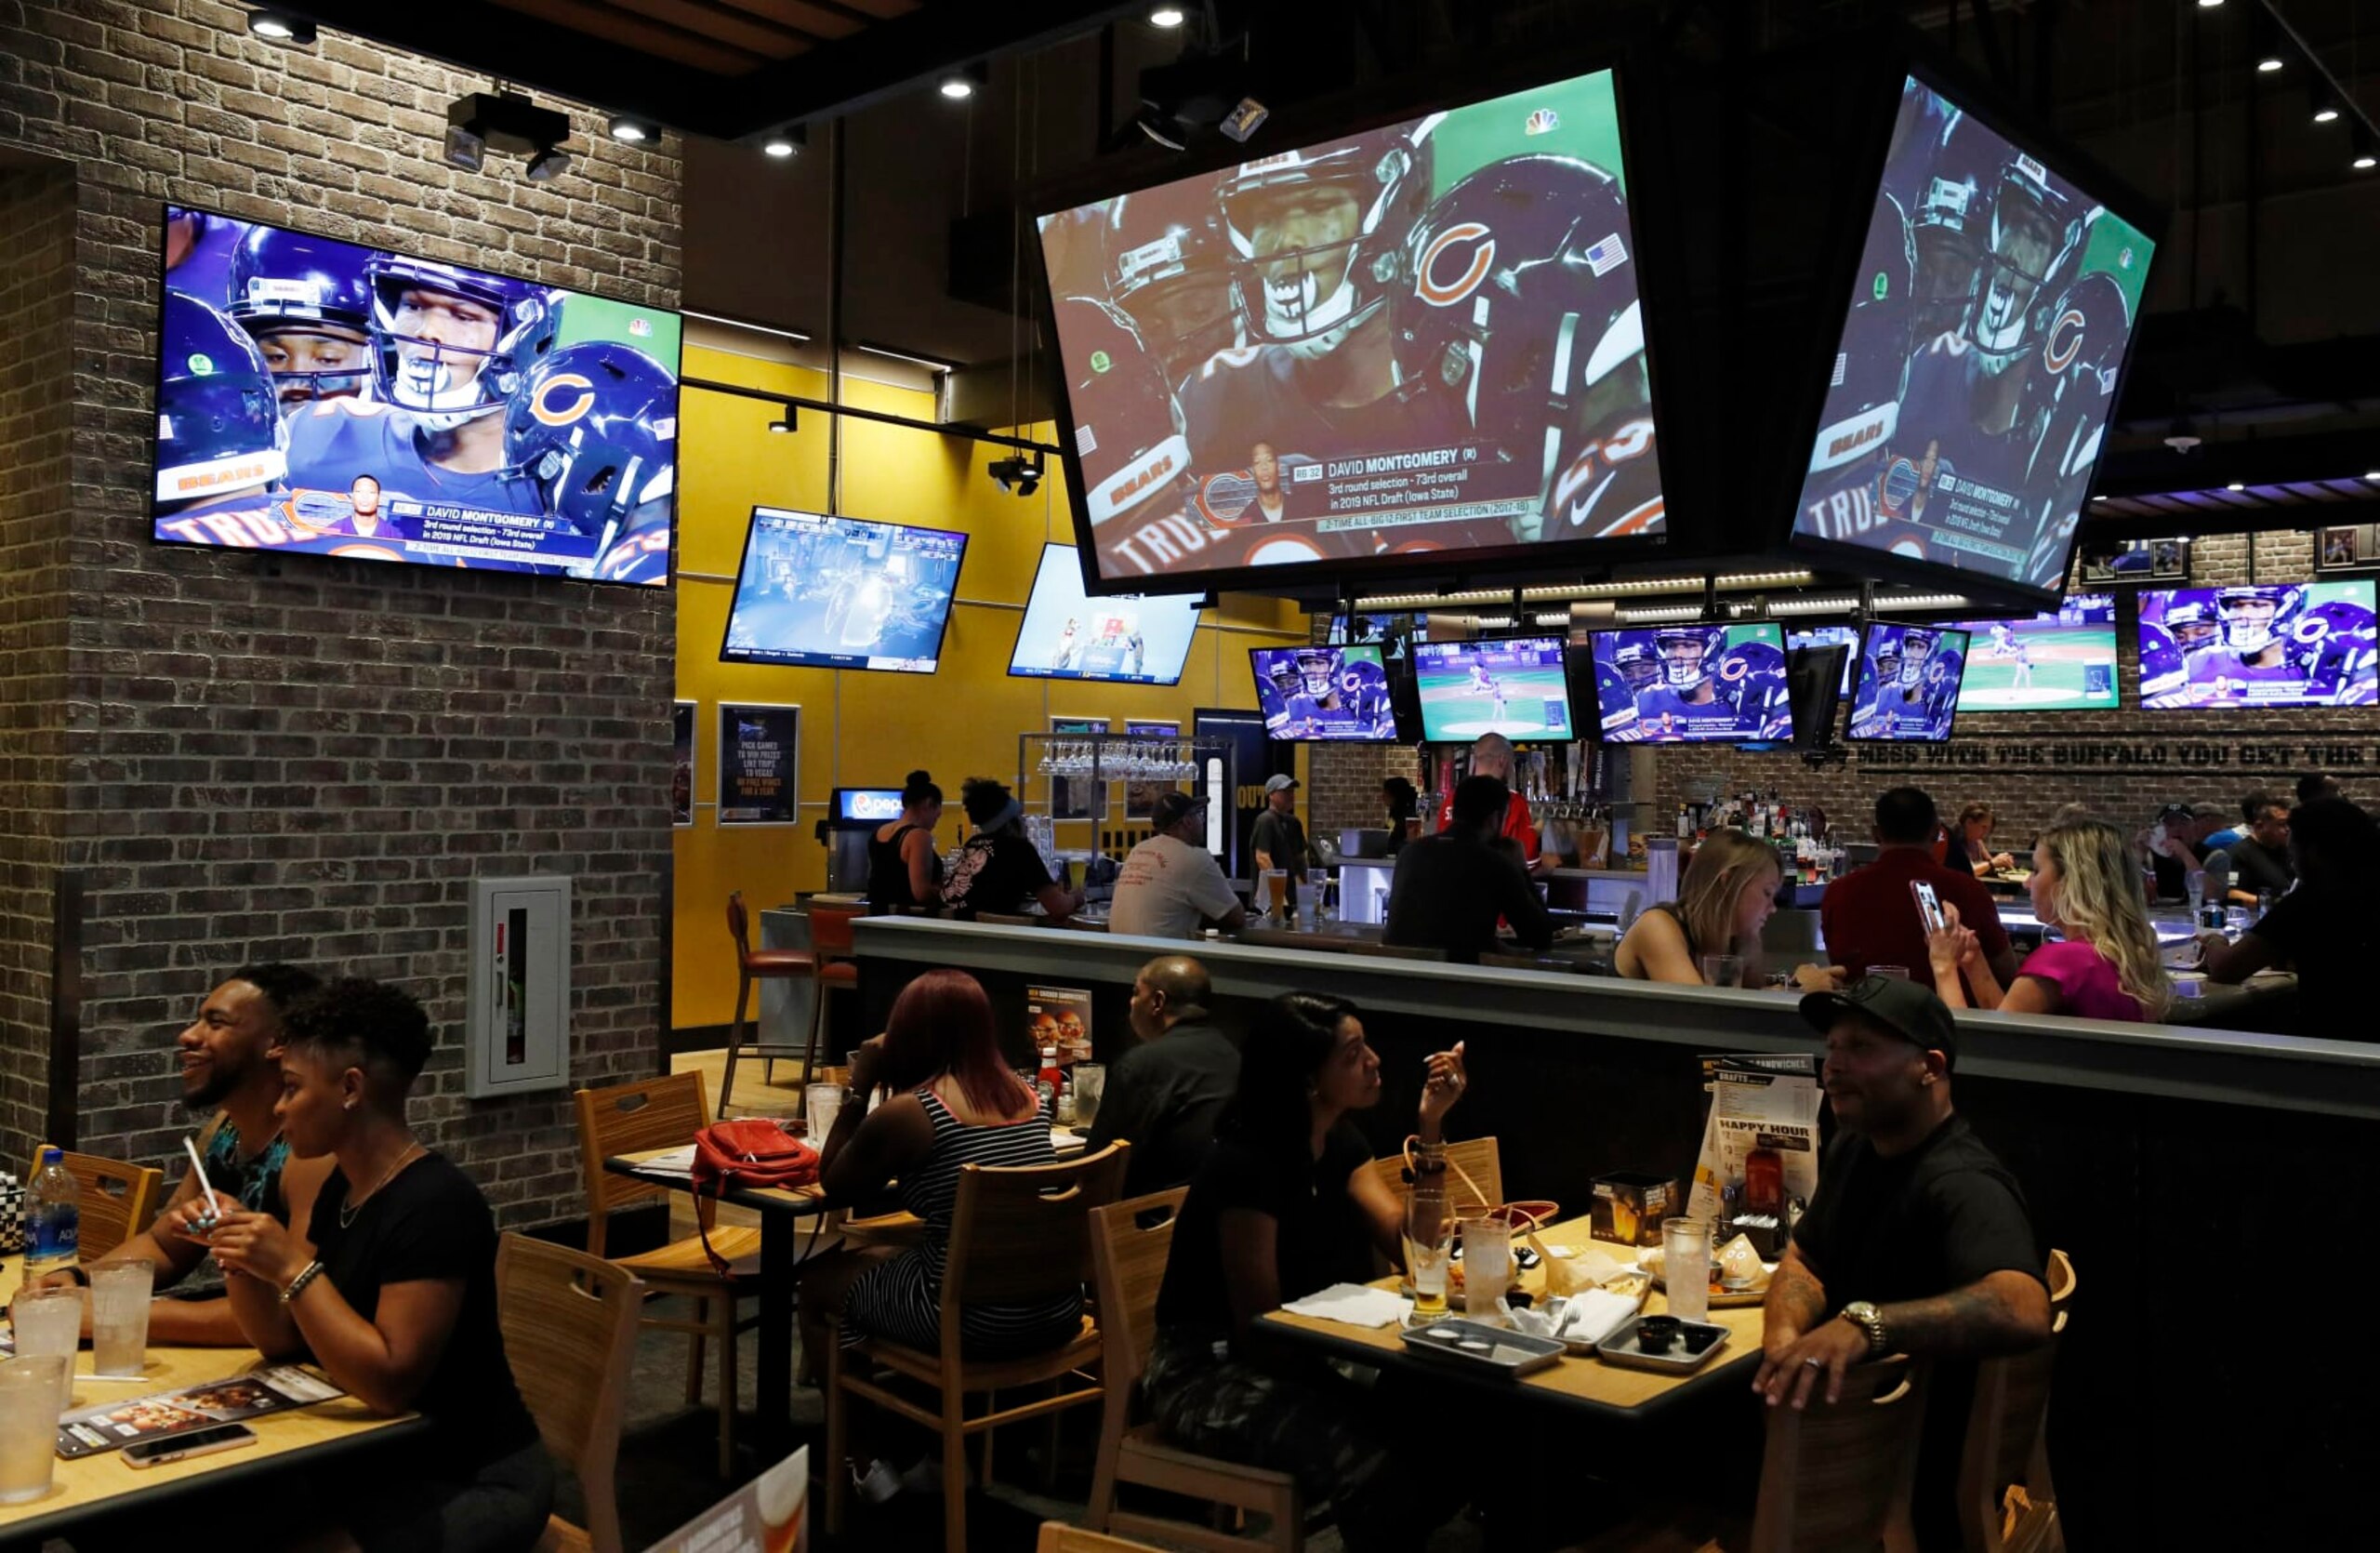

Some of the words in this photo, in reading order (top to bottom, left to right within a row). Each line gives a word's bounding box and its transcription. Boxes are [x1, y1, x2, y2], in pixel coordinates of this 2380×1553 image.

[1829, 420, 1884, 459] BEARS
[1329, 459, 1364, 478] DAVID
[1366, 448, 1459, 473] MONTGOMERY
[1462, 447, 1477, 462] (R)
[178, 464, 265, 491] BEARS
[1110, 455, 1173, 507] BEARS
[1328, 482, 1344, 496] 3rd
[1345, 480, 1369, 494] round
[1370, 476, 1409, 492] selection
[1415, 473, 1437, 487] 73rd
[1437, 469, 1468, 484] overall
[1330, 499, 1341, 511] in
[1340, 496, 1362, 510] 2019
[1363, 494, 1381, 507] NFL
[1382, 491, 1405, 506] Draft
[1405, 489, 1430, 505] (Iowa
[1431, 485, 1460, 502] State)
[427, 506, 461, 520] DAVID
[461, 511, 541, 528] MONTGOMERY
[1395, 511, 1418, 524] FIRST
[1419, 509, 1442, 522] TEAM
[1443, 504, 1488, 520] SELECTION
[431, 531, 451, 542] 2019
[452, 533, 468, 543] NFL
[469, 535, 489, 546] Draft
[438, 522, 462, 533] round
[463, 524, 496, 536] selection
[520, 531, 546, 541] overall
[1858, 743, 1921, 764] MESS
[1925, 743, 1989, 764] WITH
[1993, 744, 2046, 764] THE
[2051, 744, 2167, 765] BUFFALO
[2176, 744, 2229, 765] YOU
[2238, 744, 2295, 765] GET
[2303, 744, 2366, 765] THE
[755, 769, 774, 777] VEGAS
[1719, 1072, 1749, 1082] DRAFTS
[1720, 1120, 1766, 1133] HAPPY
[1769, 1124, 1810, 1137] HOUR
